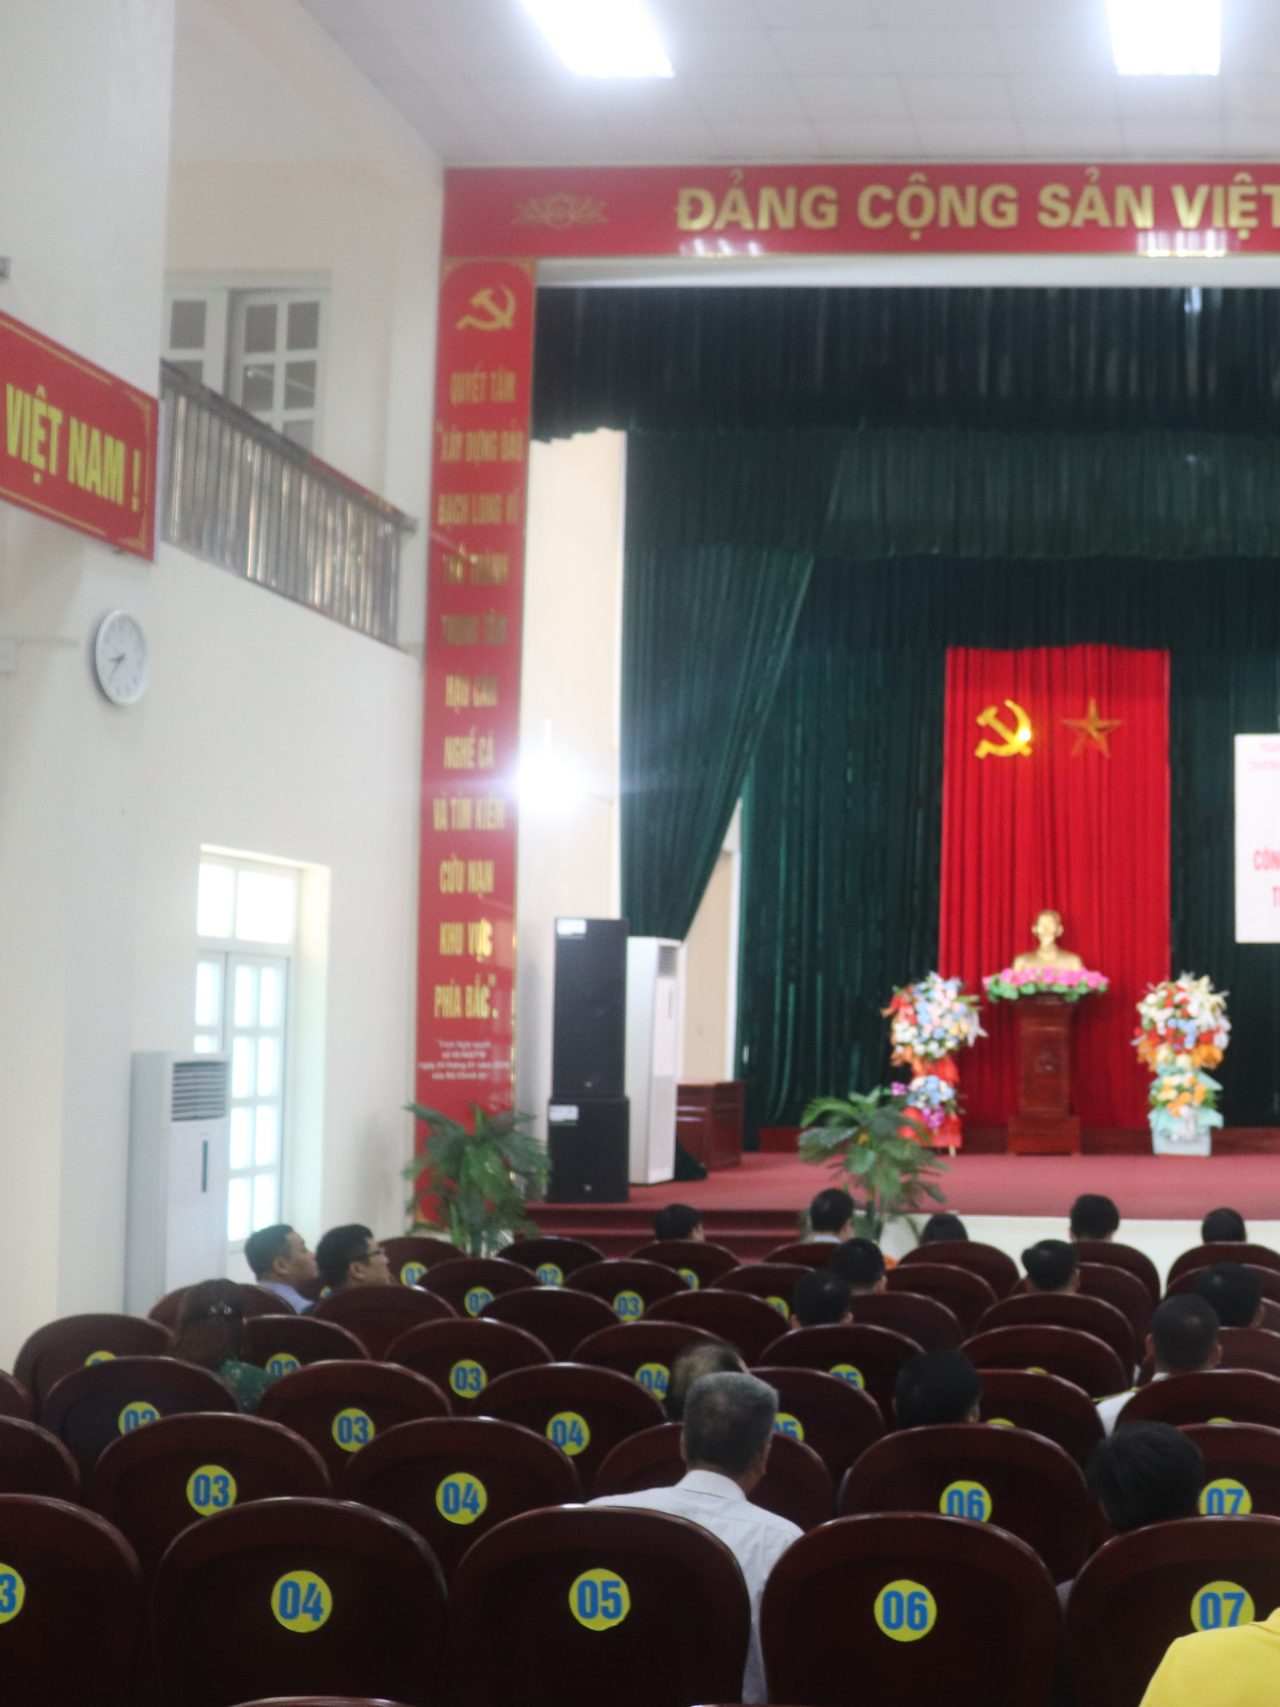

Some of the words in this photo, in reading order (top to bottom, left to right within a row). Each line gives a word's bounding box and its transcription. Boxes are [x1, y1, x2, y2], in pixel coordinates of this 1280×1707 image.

[677, 169, 838, 230] ĐẢNG
[857, 173, 1019, 240] CỘNG
[1038, 166, 1154, 230] SẢN
[6, 383, 63, 486] VIỆT
[67, 416, 126, 506] NAM
[454, 1367, 481, 1391] 03
[640, 1370, 667, 1393] 04
[338, 1416, 369, 1444] 03
[552, 1420, 583, 1447] 04
[193, 1474, 230, 1507] 03
[442, 1481, 480, 1514] 04
[947, 1489, 984, 1521] 06
[1206, 1488, 1244, 1514] 07
[0, 1573, 16, 1613] 3
[279, 1581, 323, 1621] 04
[577, 1580, 622, 1620] 05
[882, 1591, 928, 1631] 06
[1200, 1592, 1246, 1630] 07
